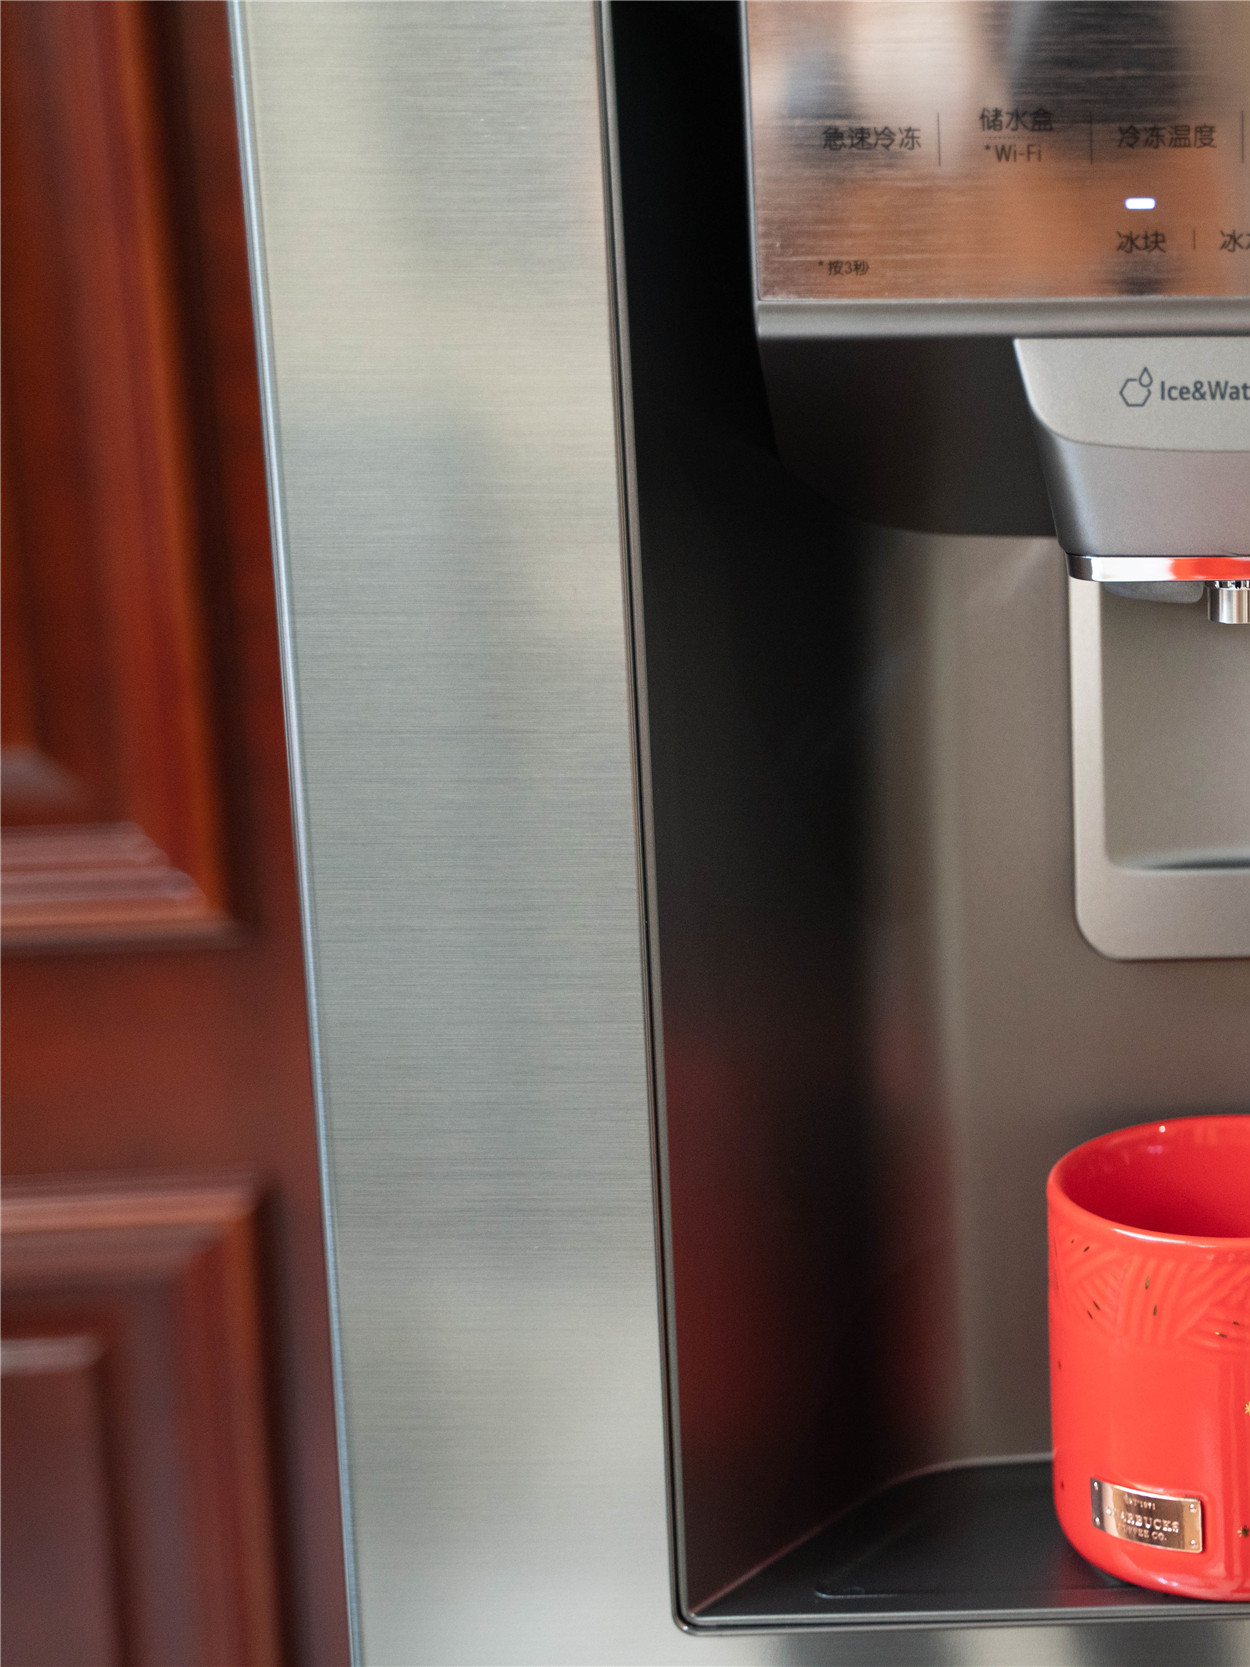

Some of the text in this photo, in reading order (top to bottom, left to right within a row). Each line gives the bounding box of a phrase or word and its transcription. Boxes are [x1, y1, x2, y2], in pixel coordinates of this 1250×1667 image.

[979, 107, 1055, 133] 储水盒
[822, 126, 922, 151] 急速冷冻
[1117, 124, 1218, 150] 冷冻温度
[1116, 231, 1167, 254] 冰块
